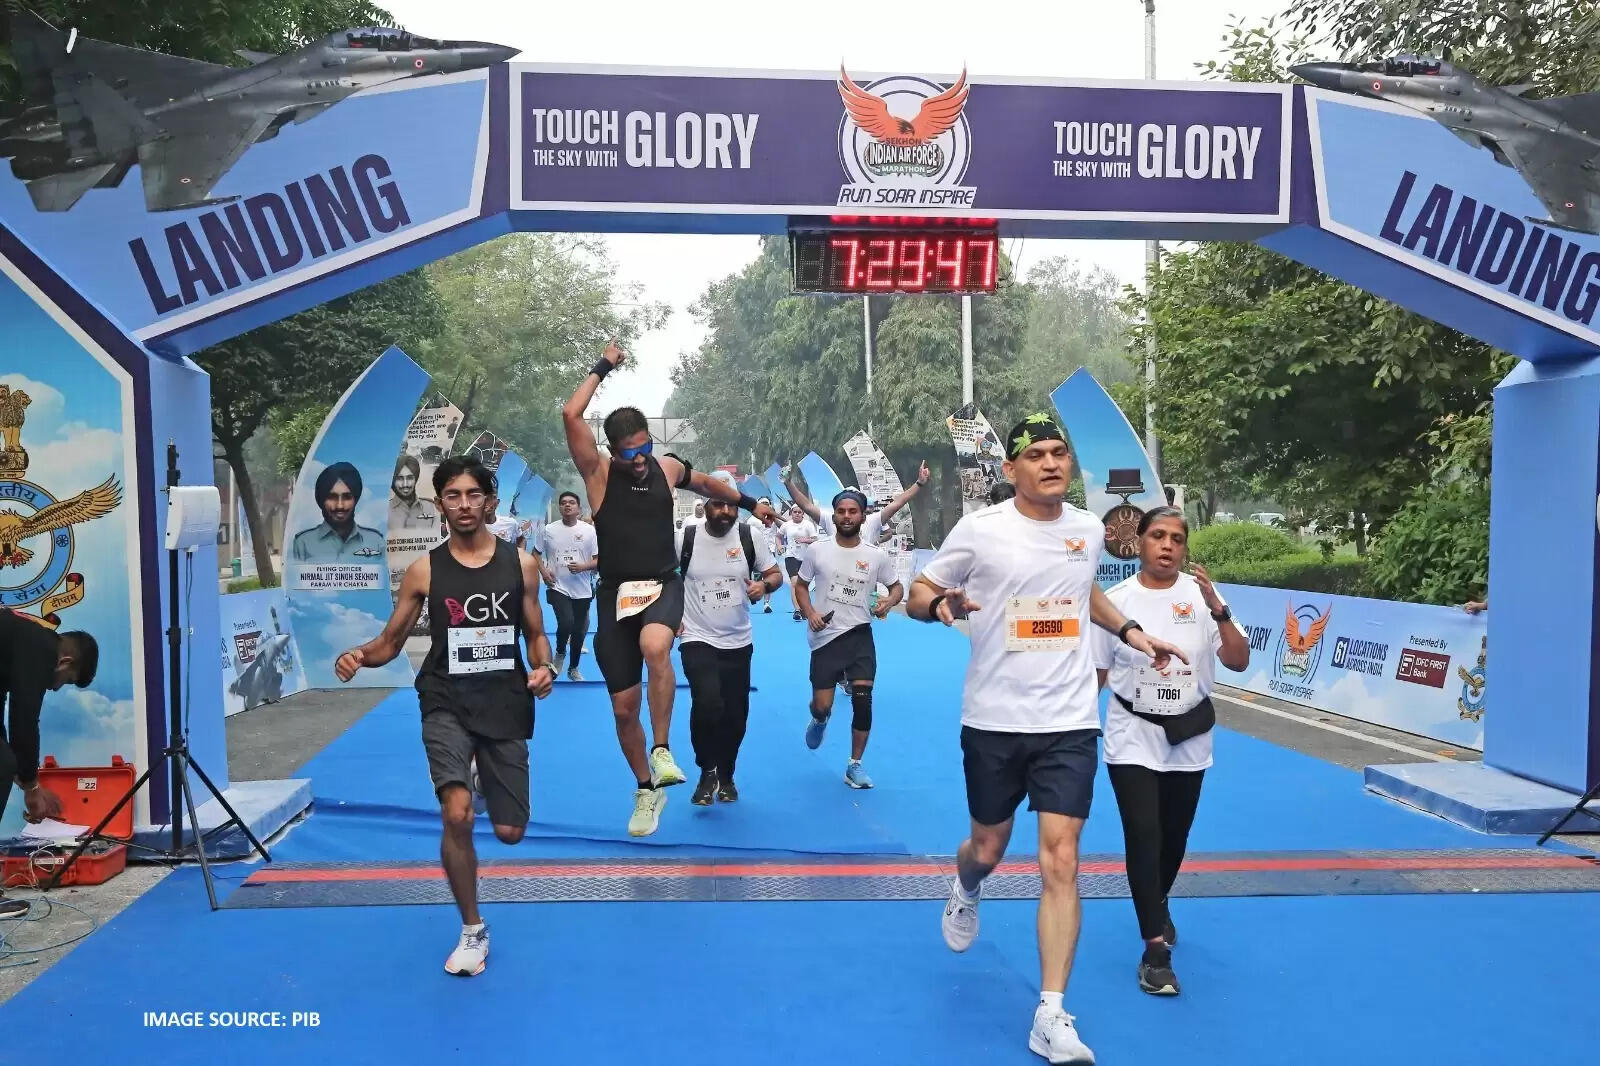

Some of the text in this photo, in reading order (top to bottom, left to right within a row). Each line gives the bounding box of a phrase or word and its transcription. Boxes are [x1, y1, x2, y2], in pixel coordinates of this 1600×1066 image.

[532, 108, 619, 145] TOUCH
[625, 110, 760, 169] GLORY
[885, 137, 922, 146] SEKHON
[1053, 121, 1132, 157] TOUCH
[532, 150, 618, 168] THE SKY WITH
[868, 142, 938, 166] INDIAN AIR FORCE
[1137, 123, 1262, 180] GLORY
[881, 165, 926, 173] MARATHON
[1053, 160, 1131, 178] THE SKY WITH
[839, 188, 975, 205] RUN SOAR INSPIRE
[128, 153, 411, 315] LANDING
[1379, 170, 1600, 326] LANDING
[832, 240, 995, 287] 7:29:47
[0, 482, 39, 502] तीय
[300, 572, 379, 581] NIRMAL JIT SINGH SEKHON
[463, 591, 509, 622] GK
[1032, 620, 1063, 634] 23590
[472, 645, 498, 659] 50261
[1348, 639, 1389, 661] LOCATIONS
[1409, 635, 1448, 651] Presented By
[1344, 658, 1383, 677] ACROSS INDIA
[1415, 657, 1447, 671] IDFC FIRST
[1412, 668, 1428, 679] Bank
[1156, 688, 1181, 700] 17061
